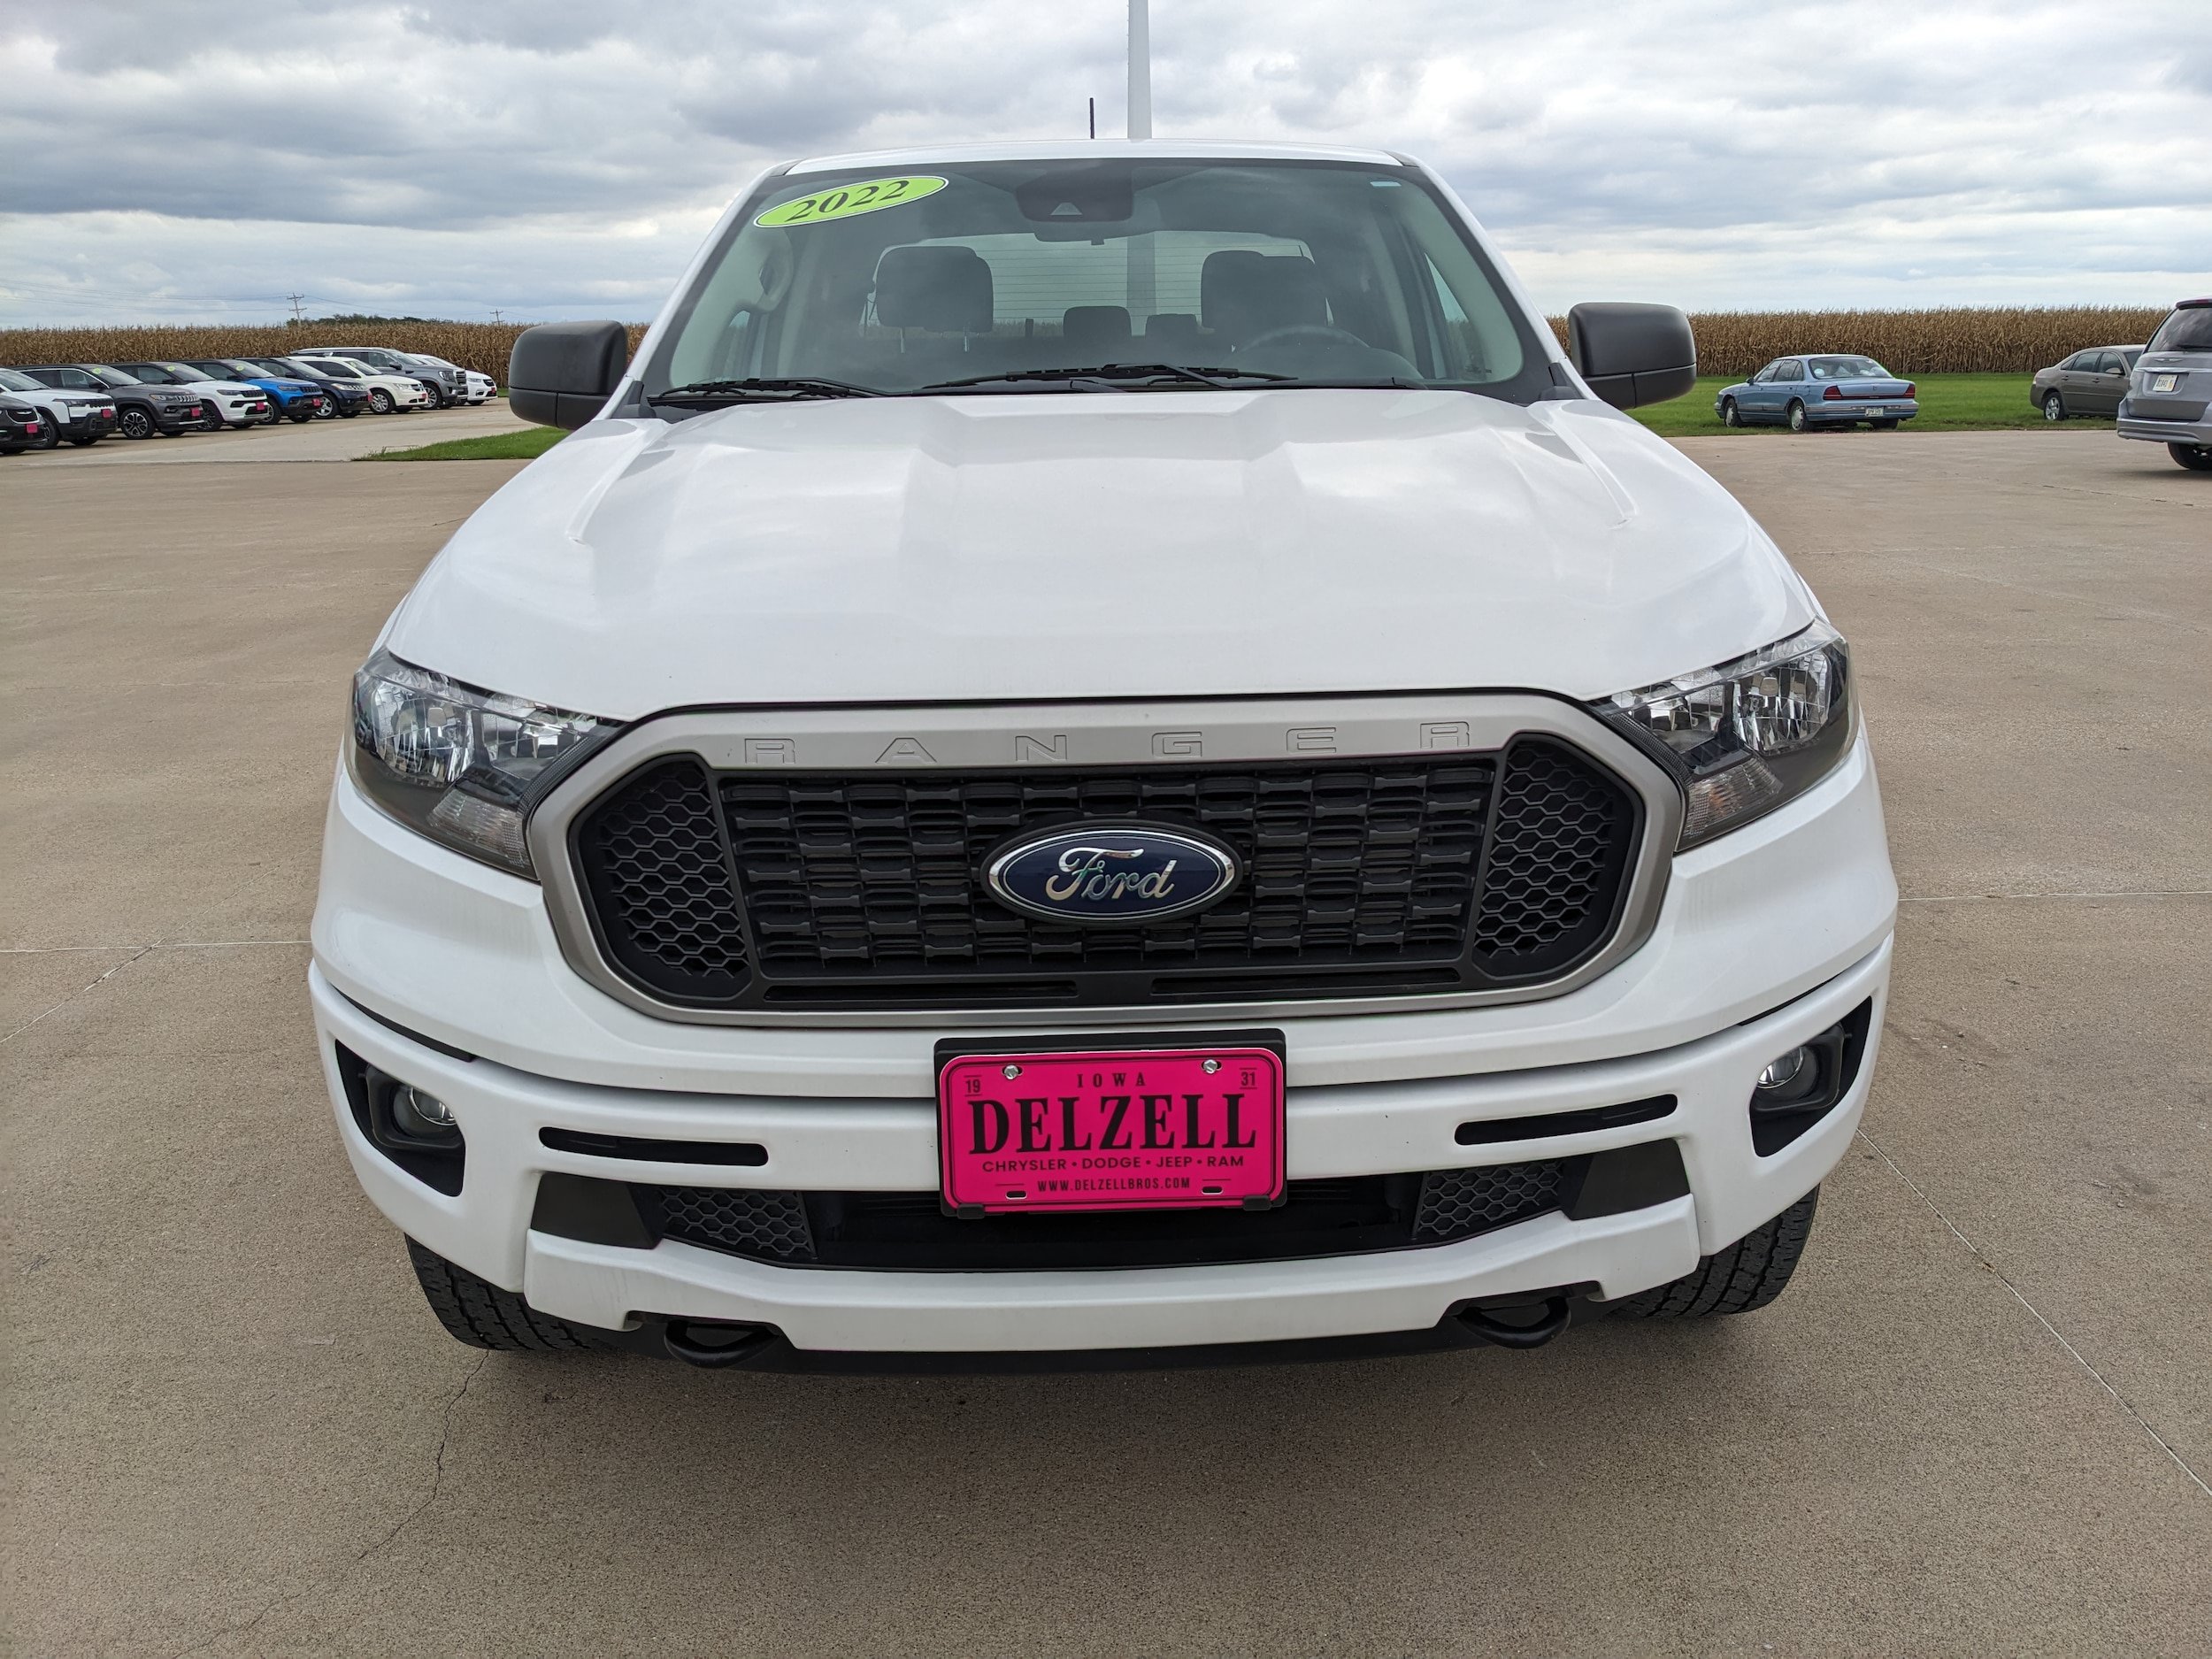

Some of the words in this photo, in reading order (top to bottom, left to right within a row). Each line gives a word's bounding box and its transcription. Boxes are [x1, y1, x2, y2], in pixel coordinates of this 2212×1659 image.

[784, 180, 910, 222] 2022
[744, 720, 1471, 765] RANGER
[1045, 846, 1178, 901] Ford
[964, 1079, 981, 1094] 19
[1077, 1071, 1146, 1088] IOWA
[1240, 1071, 1256, 1087] 31
[968, 1093, 1256, 1155] DELZELL
[982, 1158, 1066, 1172] CHRYSLER
[1082, 1156, 1141, 1169] DODGE
[1156, 1156, 1193, 1168] JEEP
[1207, 1155, 1244, 1167] RAM
[1037, 1178, 1190, 1192] WWW.DELZELLBROS.COM
